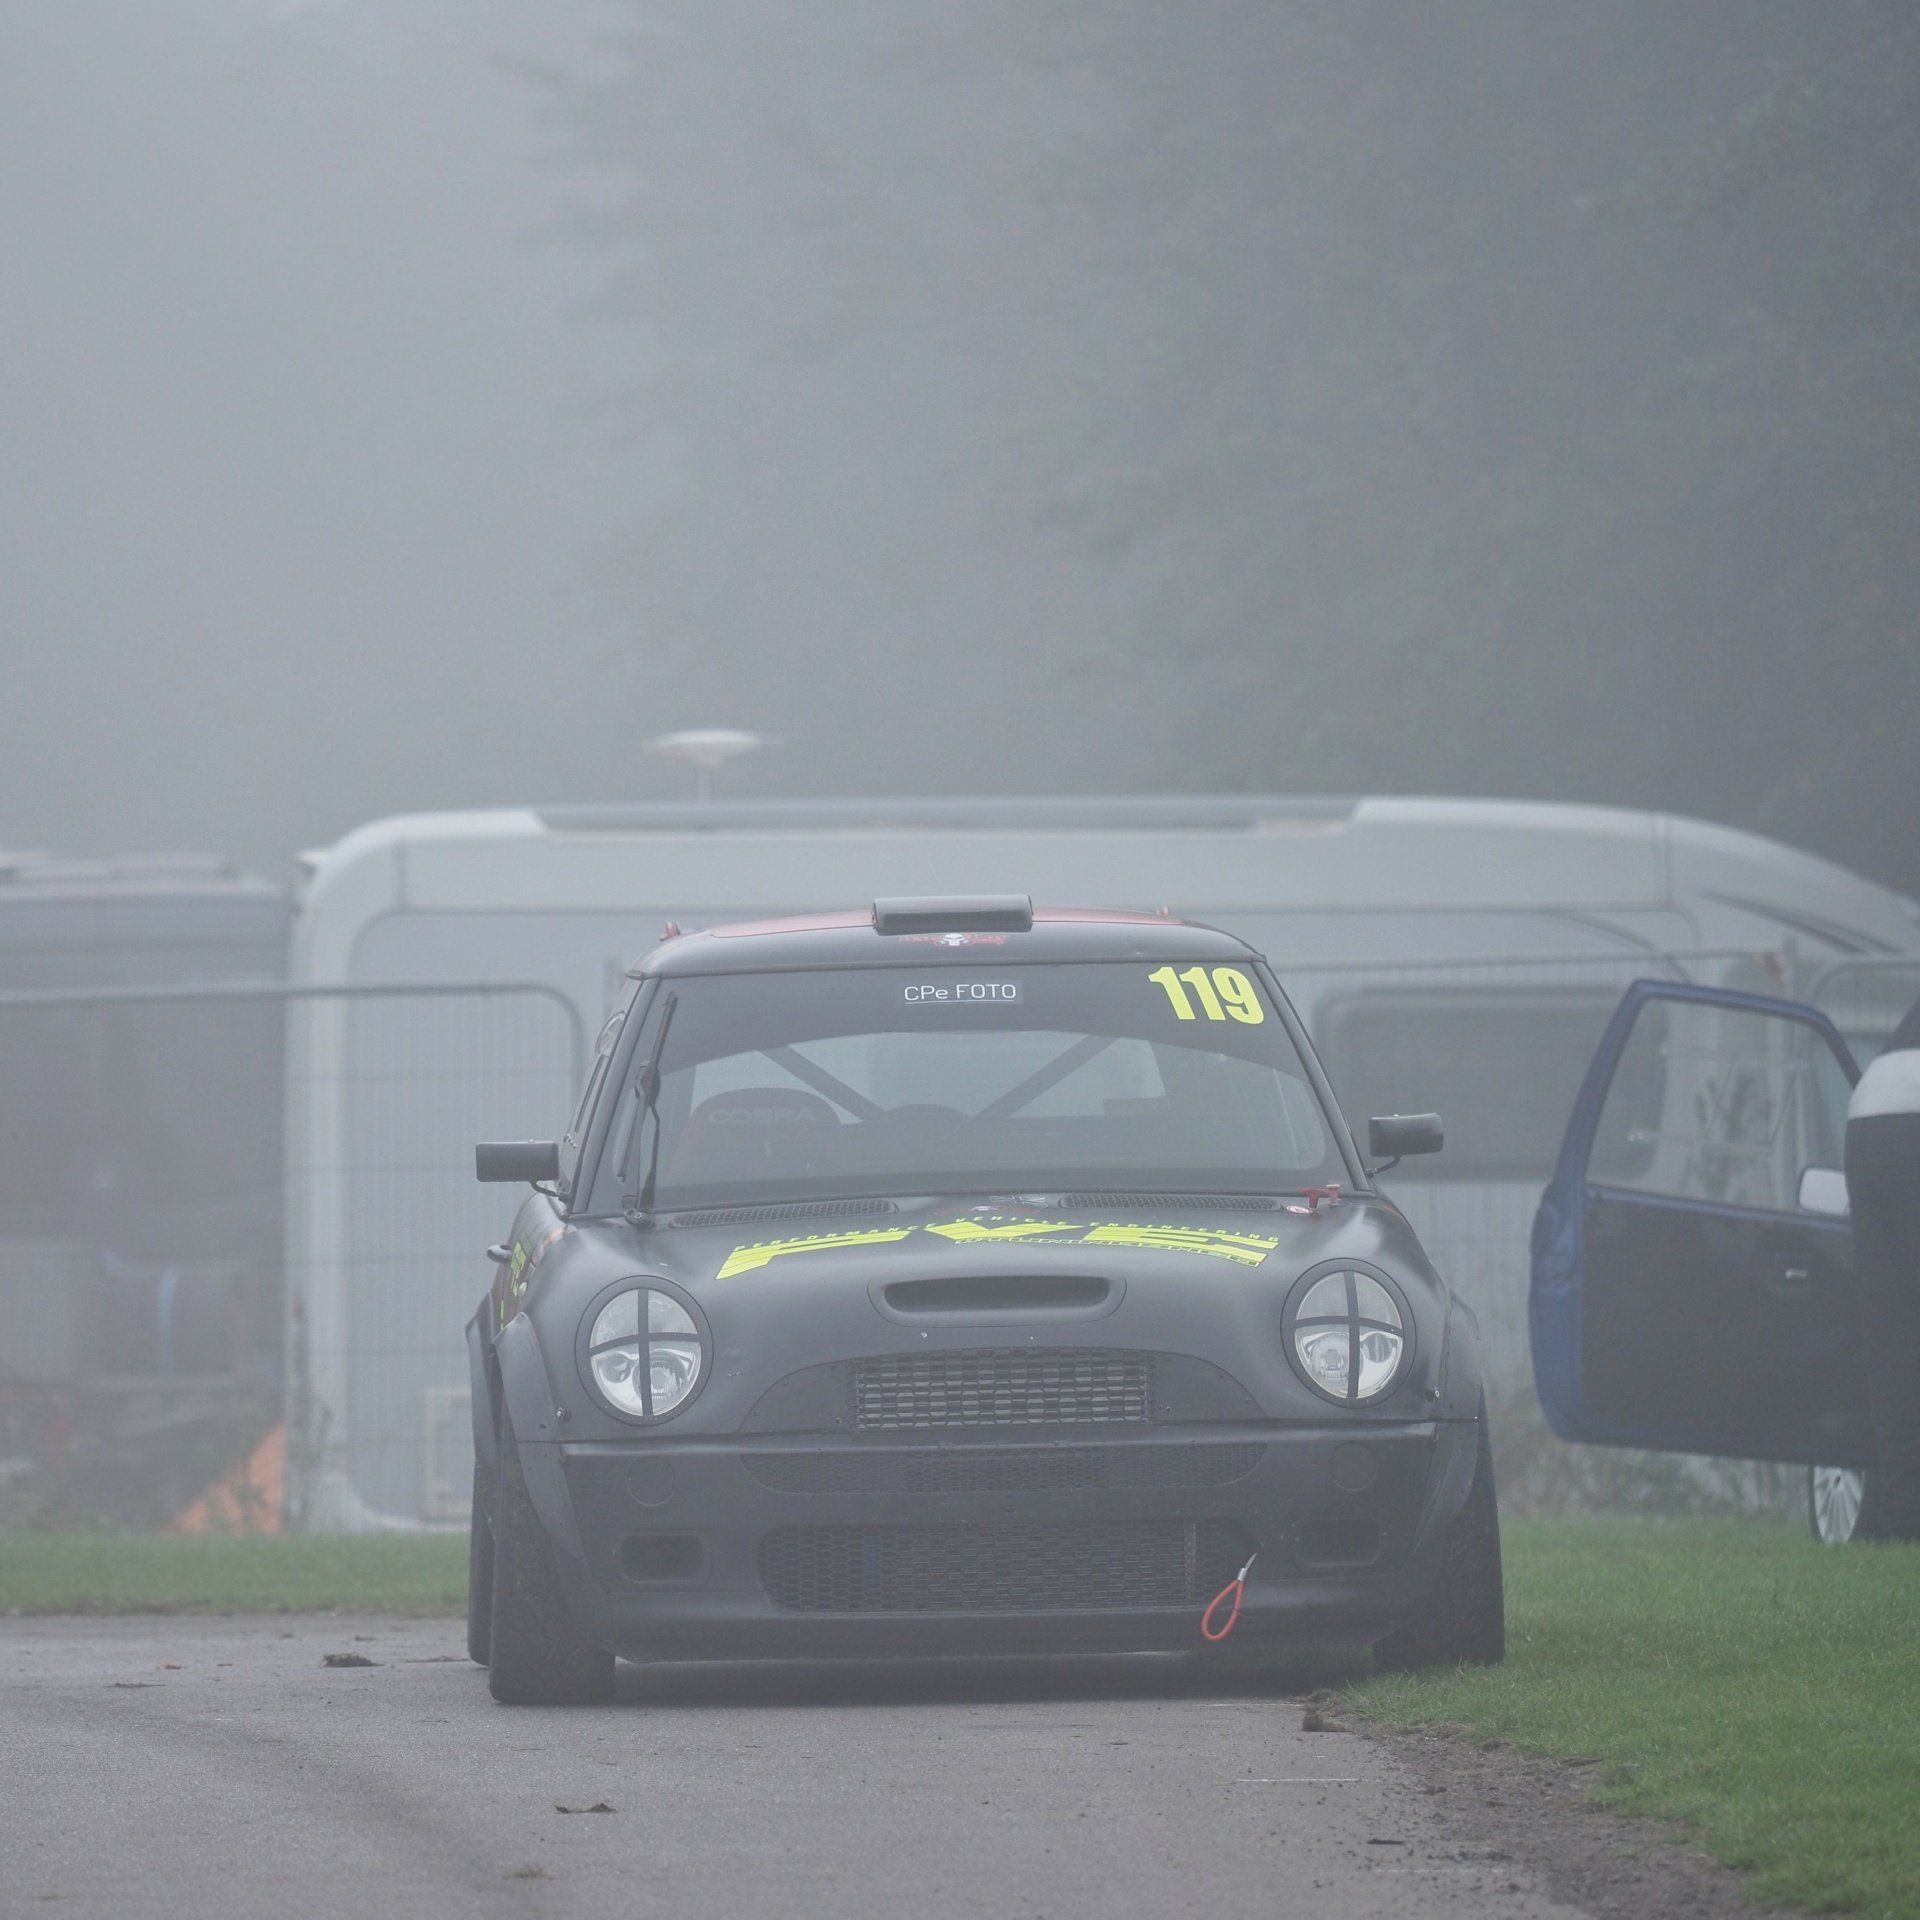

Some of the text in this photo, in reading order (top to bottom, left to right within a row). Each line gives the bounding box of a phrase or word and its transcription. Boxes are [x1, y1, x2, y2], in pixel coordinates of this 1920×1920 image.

[904, 983, 1017, 1001] CPe FOTO
[1147, 966, 1264, 1024] 119
[707, 1107, 815, 1124] COBRA
[1089, 1221, 1280, 1242] ENGINEERING
